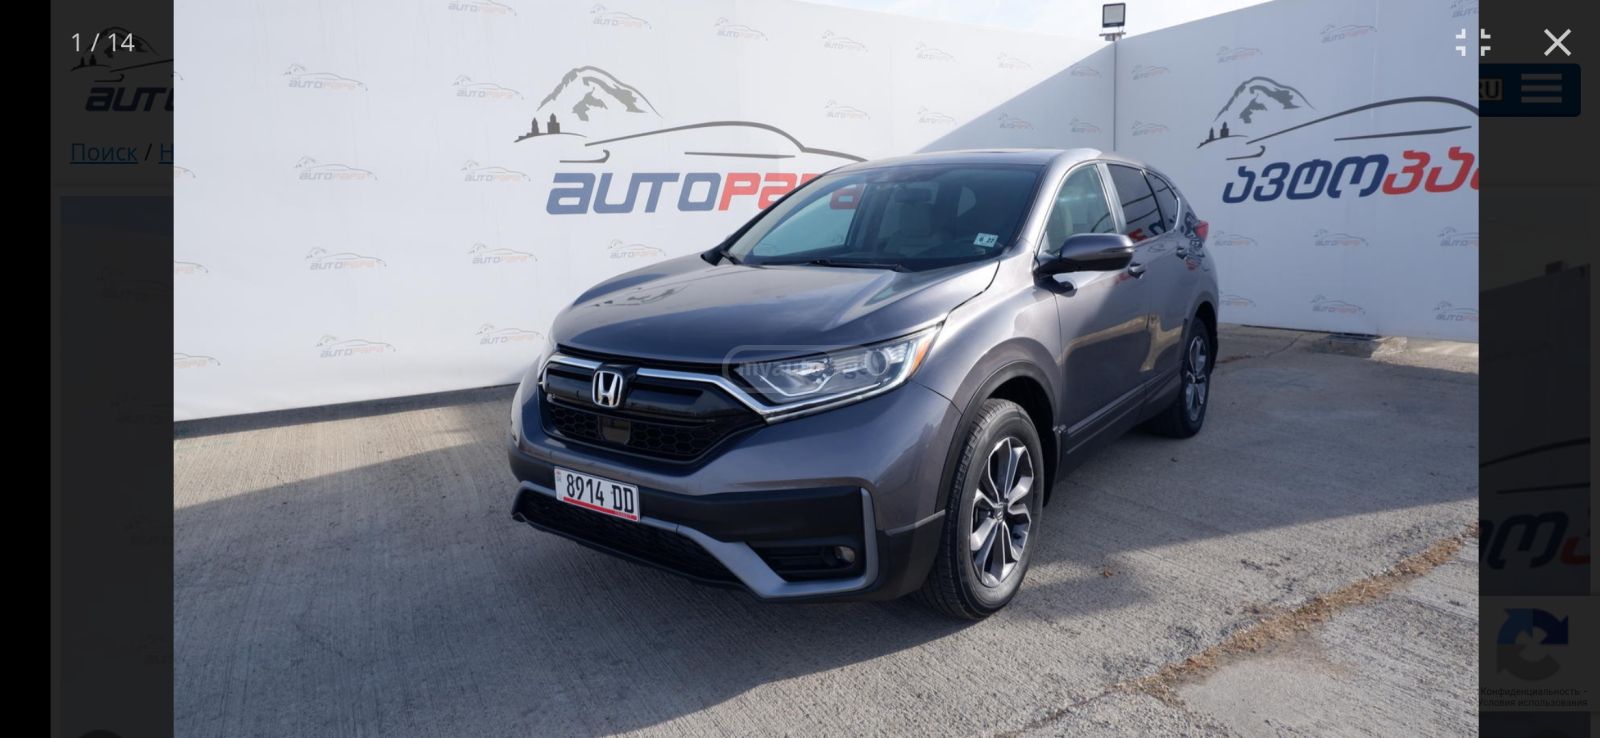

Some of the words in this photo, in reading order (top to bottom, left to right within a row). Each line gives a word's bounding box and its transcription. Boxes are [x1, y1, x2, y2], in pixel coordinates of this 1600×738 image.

[71, 143, 138, 161] Поиск
[566, 473, 605, 507] 8914
[611, 484, 635, 514] DD
